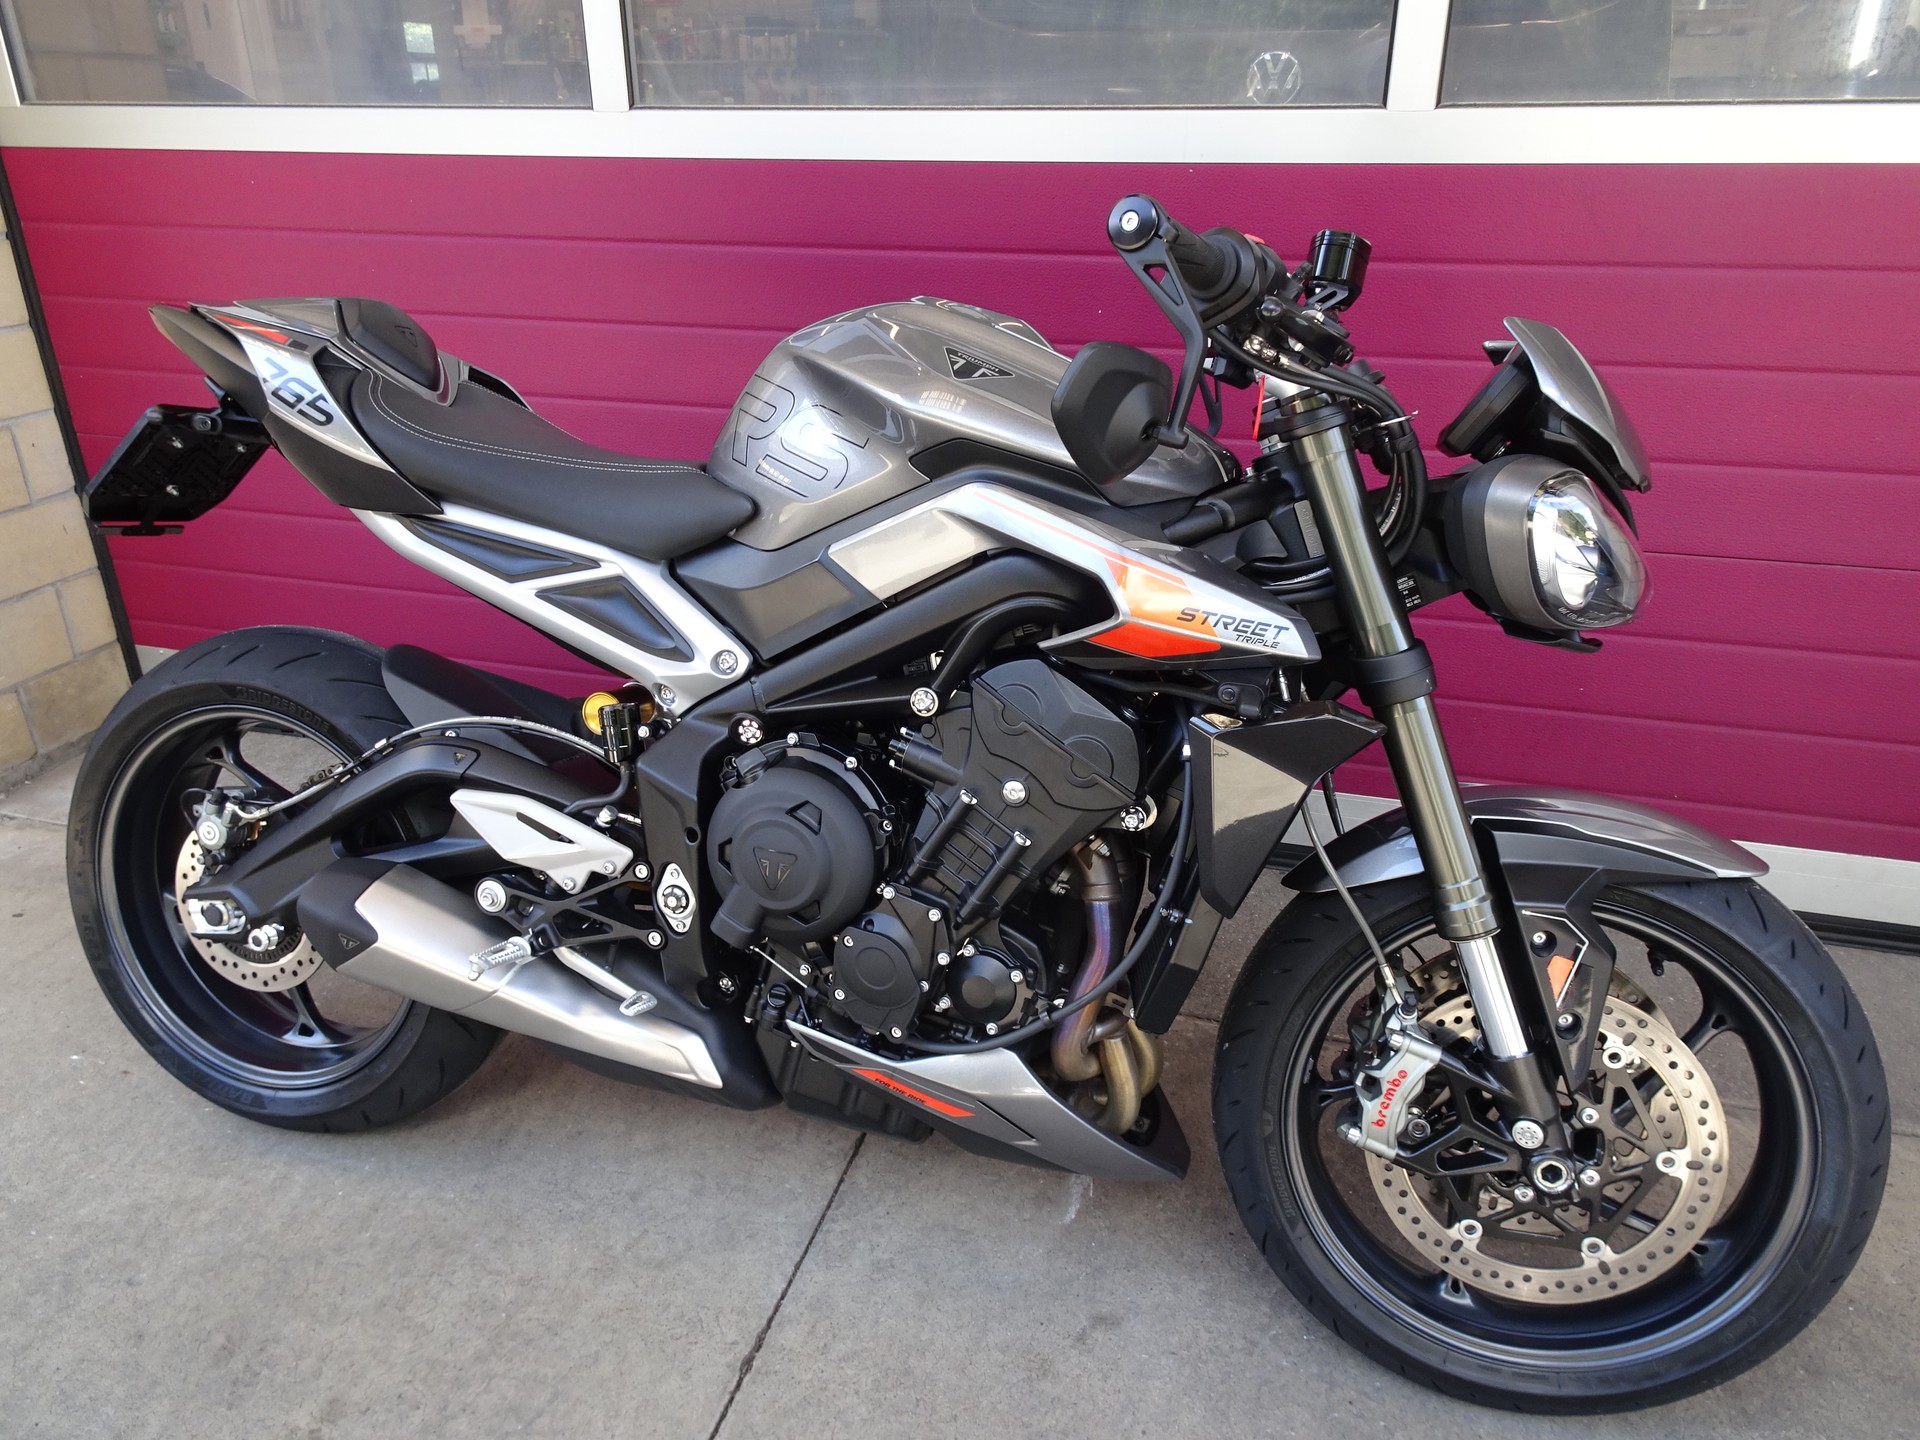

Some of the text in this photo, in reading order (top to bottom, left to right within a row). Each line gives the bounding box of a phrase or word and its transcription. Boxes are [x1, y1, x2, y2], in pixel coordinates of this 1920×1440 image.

[957, 352, 1000, 372] TRIUMPH
[263, 357, 334, 426] 765
[732, 374, 869, 498] RS
[1176, 607, 1290, 640] STREET
[1235, 634, 1280, 649] TRIPLE
[874, 1078, 927, 1104] FOR THE RIDE
[1371, 1070, 1408, 1128] brembo
[1269, 1144, 1296, 1218] BRIDGESTONE
